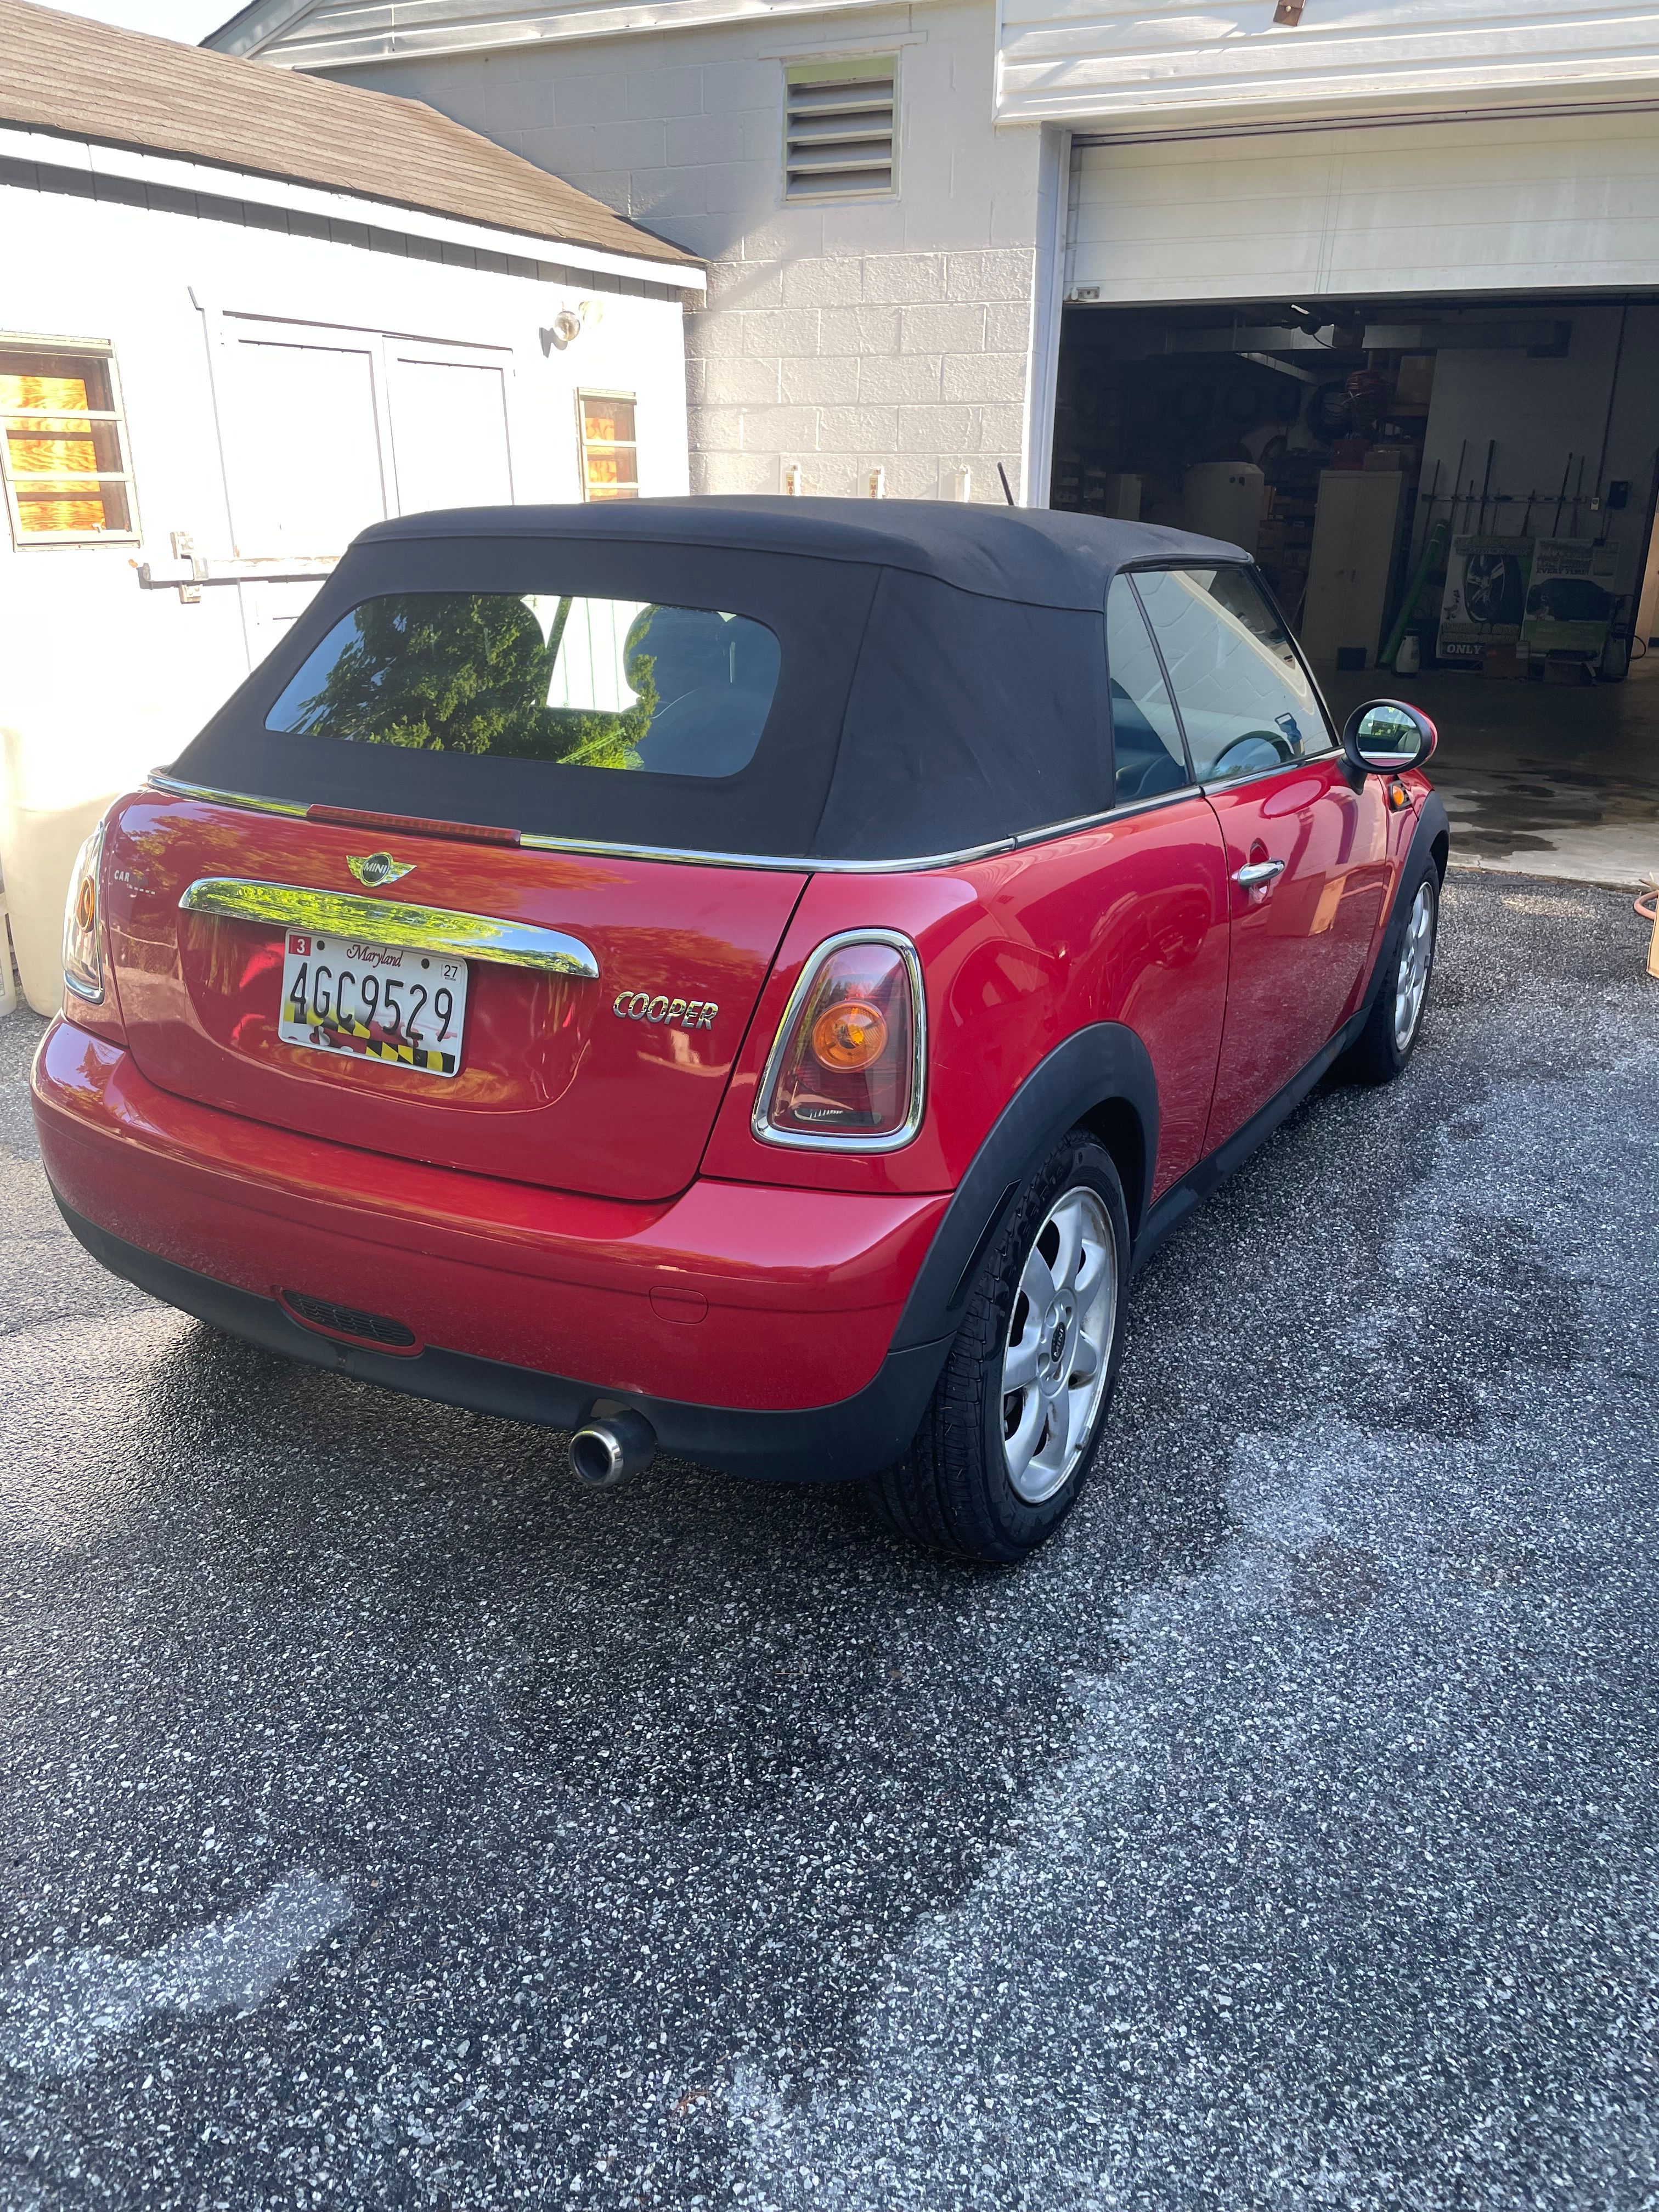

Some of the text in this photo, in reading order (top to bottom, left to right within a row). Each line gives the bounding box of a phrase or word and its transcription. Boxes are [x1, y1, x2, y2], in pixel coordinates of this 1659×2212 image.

[1447, 644, 1483, 654] ONLY
[363, 862, 388, 874] MINI
[296, 939, 306, 953] 3
[346, 944, 404, 968] Maryland
[444, 964, 459, 978] 27
[290, 962, 453, 1042] 4GC9529
[612, 991, 719, 1030] COOPER
